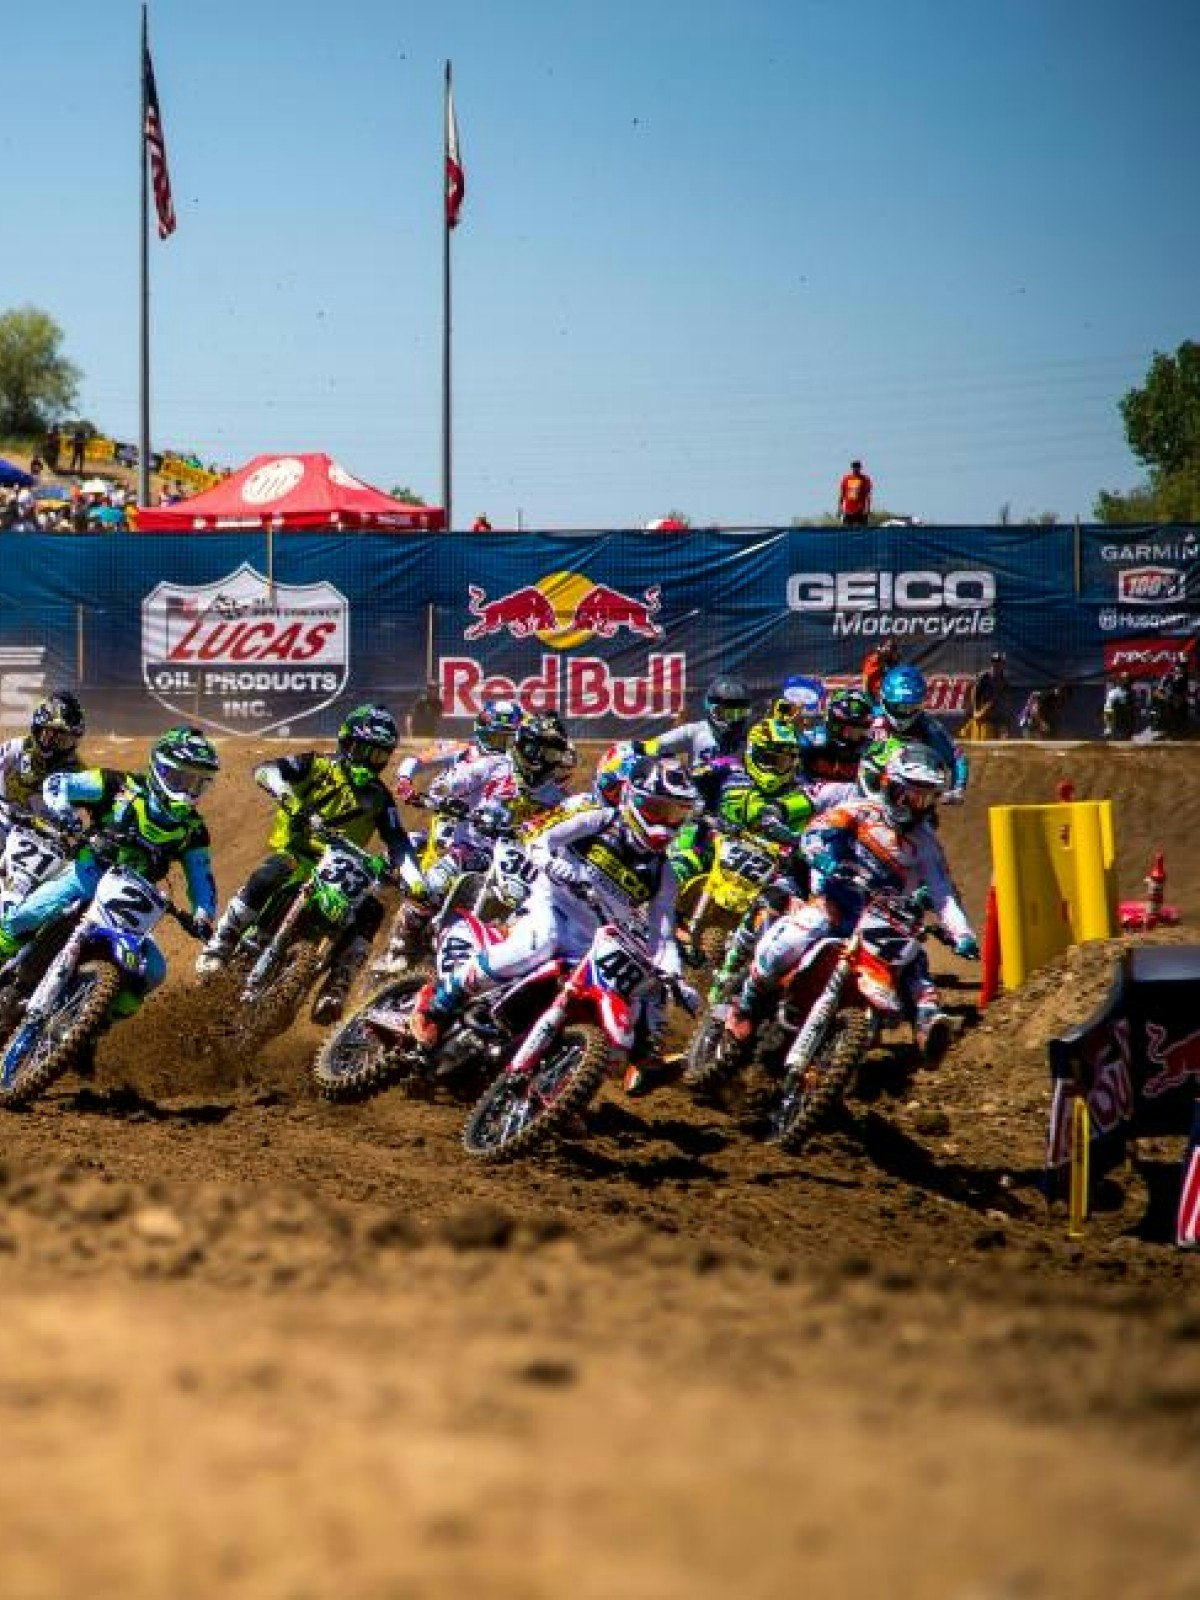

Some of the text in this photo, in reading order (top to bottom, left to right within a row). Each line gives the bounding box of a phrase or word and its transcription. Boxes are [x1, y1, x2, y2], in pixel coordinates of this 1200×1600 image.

[787, 571, 996, 612] GEICO
[170, 622, 337, 661] LUCAS
[832, 609, 996, 636] Motorcycle
[155, 671, 338, 692] OIL PRODUCTS
[438, 652, 686, 719] Red Bull
[11, 839, 55, 876] 21
[318, 857, 370, 898] 33
[500, 848, 538, 883] 30
[103, 884, 155, 927] 2
[595, 950, 646, 992] 48
